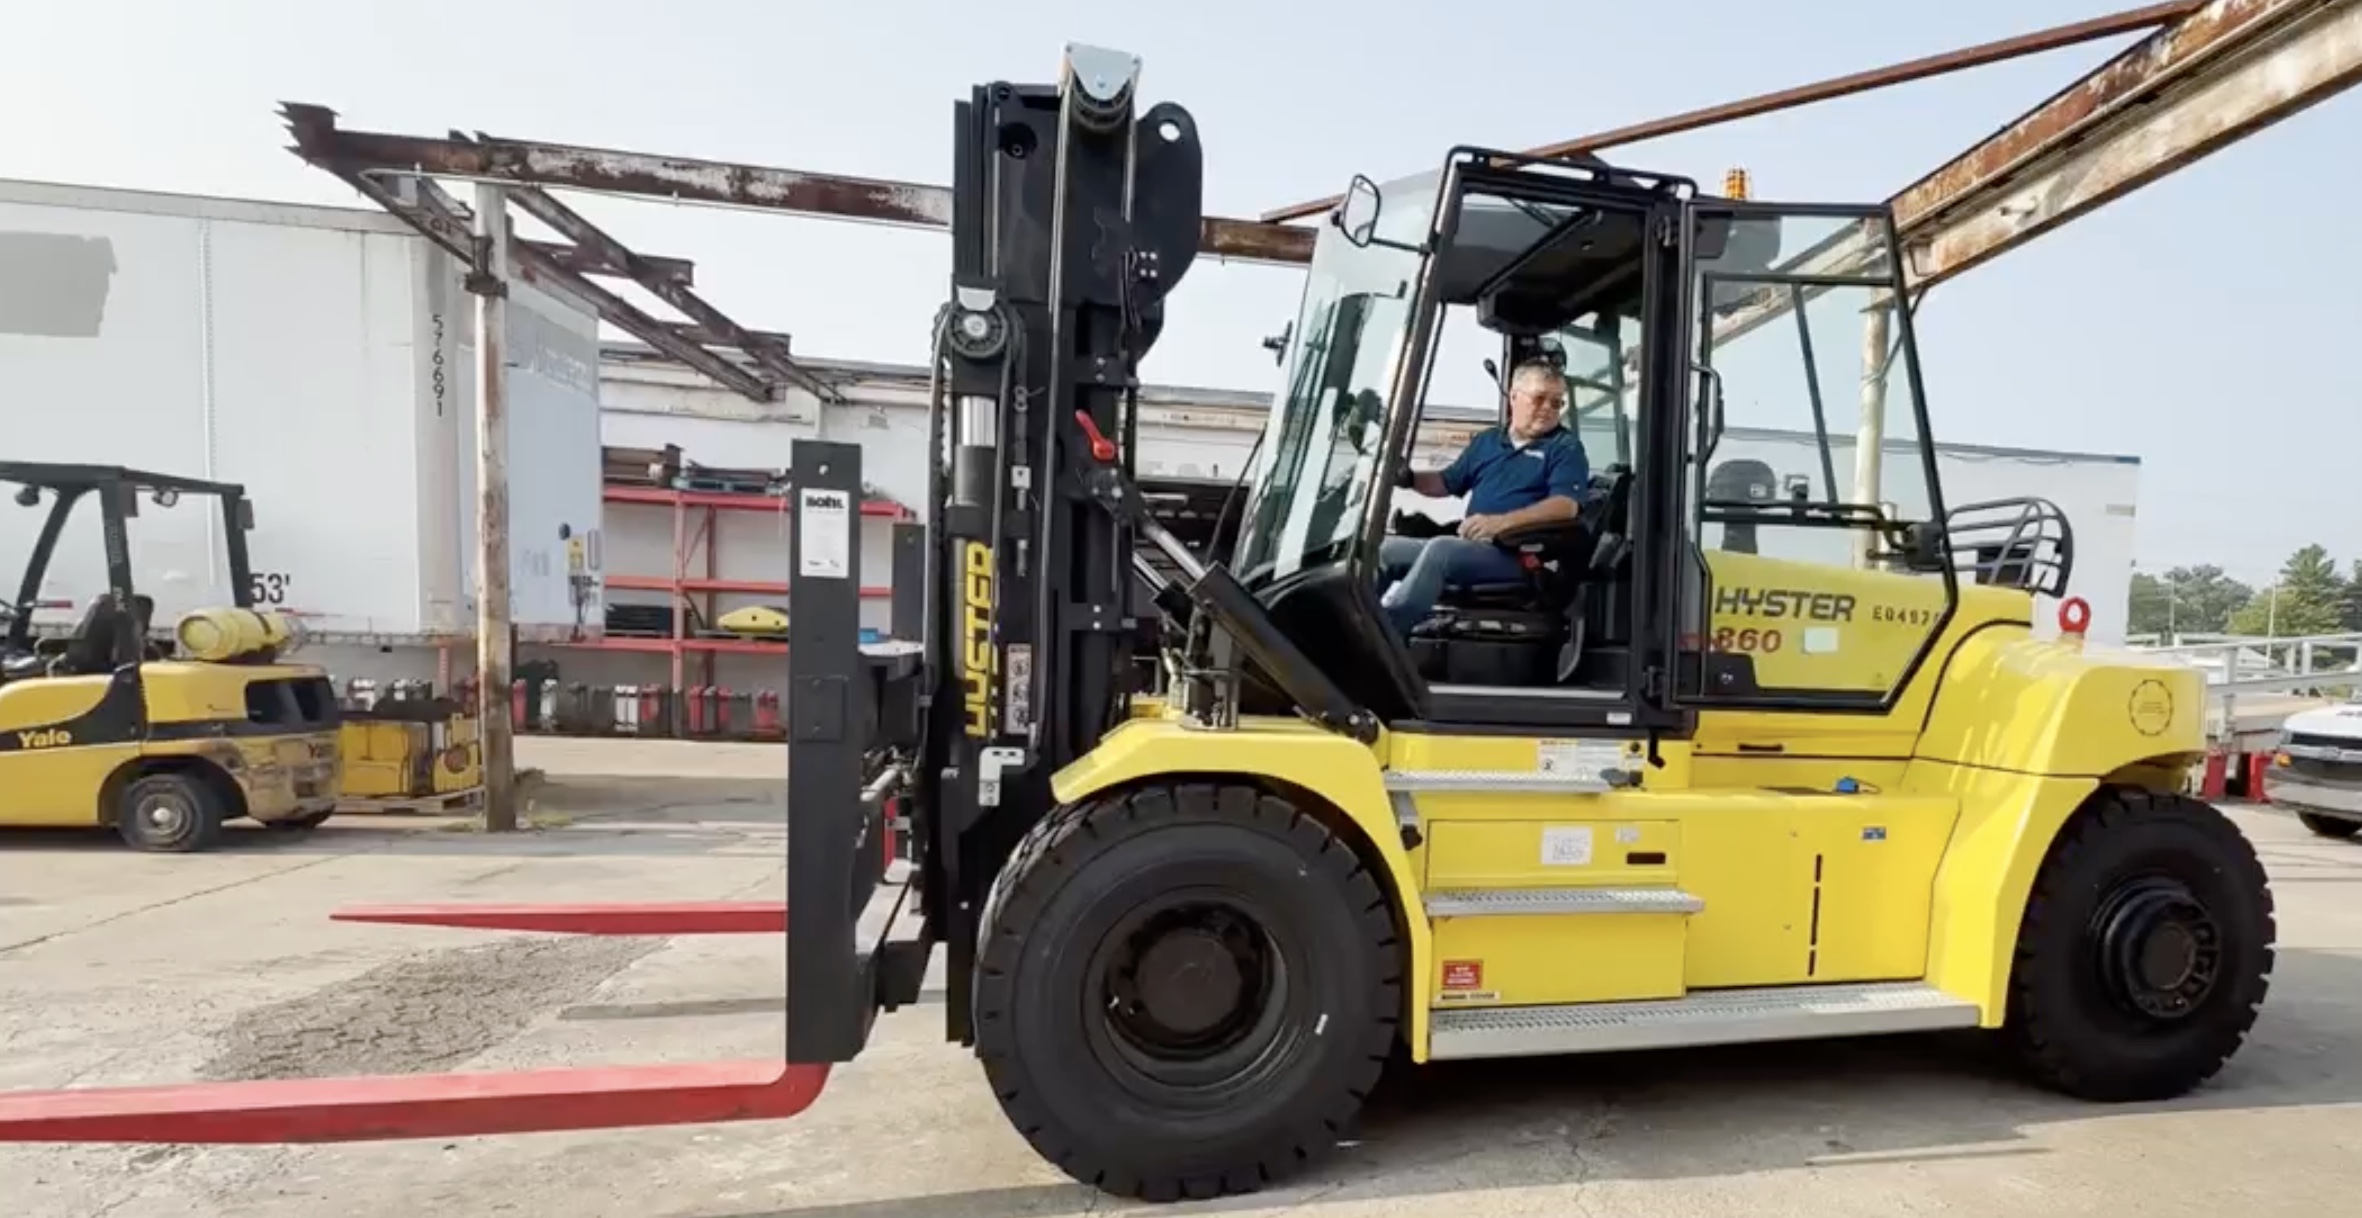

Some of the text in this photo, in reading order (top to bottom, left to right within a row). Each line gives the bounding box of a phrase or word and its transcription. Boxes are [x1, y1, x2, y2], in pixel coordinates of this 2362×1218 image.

[432, 314, 444, 417] 576691
[1714, 586, 1857, 622] HYSTER
[18, 729, 72, 749] Yale
